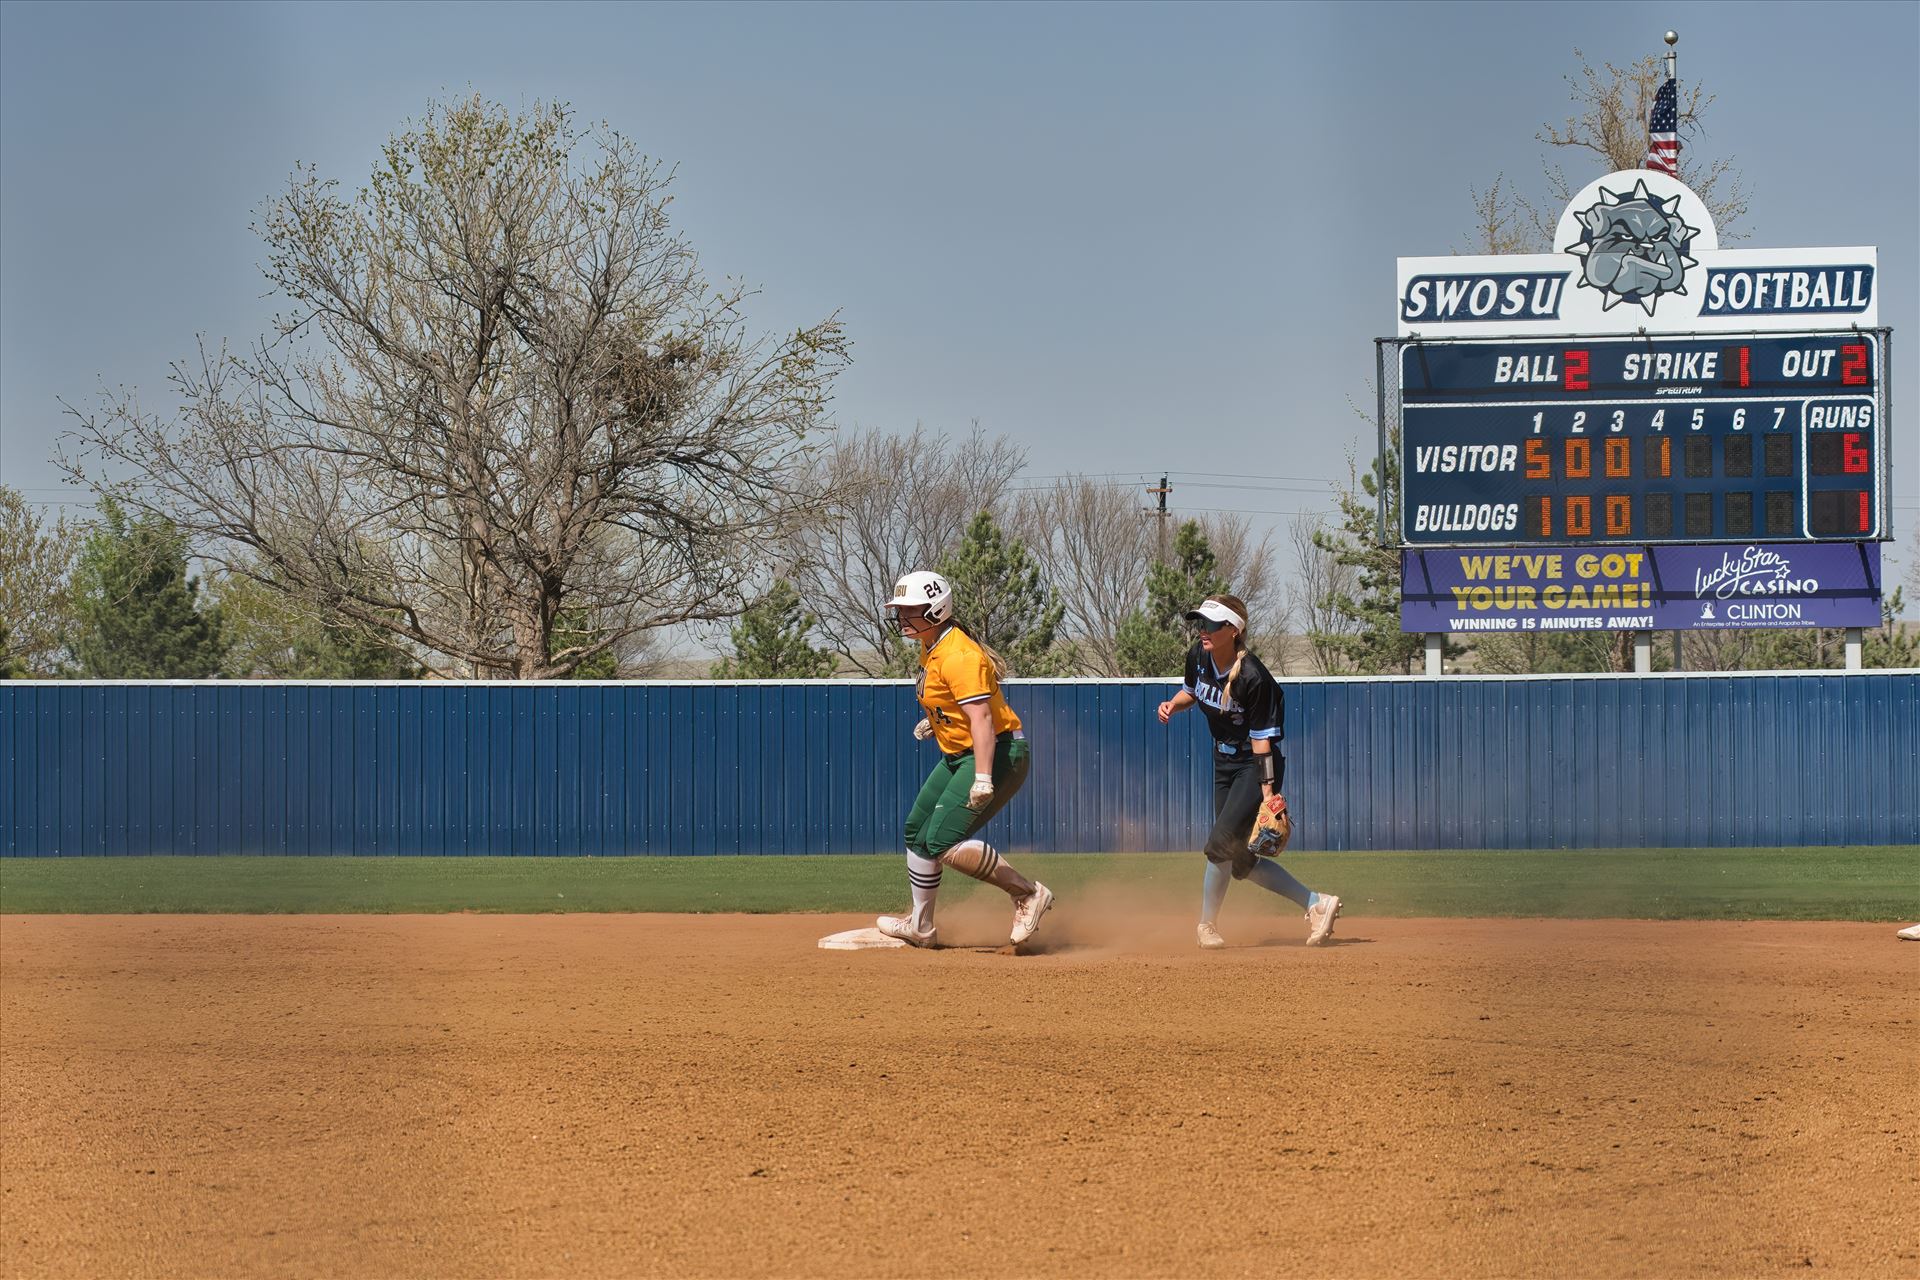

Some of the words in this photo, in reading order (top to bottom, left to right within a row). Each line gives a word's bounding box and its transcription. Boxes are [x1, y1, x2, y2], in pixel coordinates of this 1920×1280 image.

[1405, 278, 1562, 318] SWOSU
[1708, 270, 1868, 310] SOFTBALL
[1494, 355, 1558, 383] BALL
[1565, 350, 1589, 390] 2
[1623, 351, 1718, 381] STRIKE
[1740, 347, 1749, 387] 1
[1782, 349, 1836, 378] OUT
[1842, 345, 1867, 384] 2
[1655, 386, 1702, 395] SPECTRUM
[1533, 412, 1543, 433] 1
[1571, 411, 1586, 433] 2
[1610, 410, 1625, 432] 3
[1651, 409, 1665, 431] 4
[1691, 408, 1704, 430] 5
[1732, 408, 1746, 430] 6
[1773, 407, 1786, 429] 7
[1809, 405, 1872, 429] RUNS
[1416, 444, 1518, 473] VISITOR
[1526, 439, 1550, 479] 5
[1566, 438, 1591, 478] 0
[1605, 437, 1630, 477] 0
[1661, 437, 1671, 477] 1
[1843, 433, 1868, 473] 6
[1415, 503, 1519, 532] BULLDOGS
[1541, 497, 1551, 536] 1
[1567, 496, 1591, 536] 0
[1606, 496, 1631, 535] 0
[1860, 491, 1869, 531] 1
[1459, 554, 1563, 580] WE'VE
[1575, 553, 1643, 579] GOT
[923, 580, 943, 599] 24
[1450, 585, 1538, 611] YOUR
[1542, 582, 1651, 610] GAME!
[1740, 578, 1819, 595] CASINO
[1450, 618, 1518, 630] WINNING
[1522, 617, 1536, 629] IS
[1540, 616, 1603, 629] MINUTES
[1607, 615, 1654, 628] AWAY!
[1727, 603, 1801, 620] CLINTON
